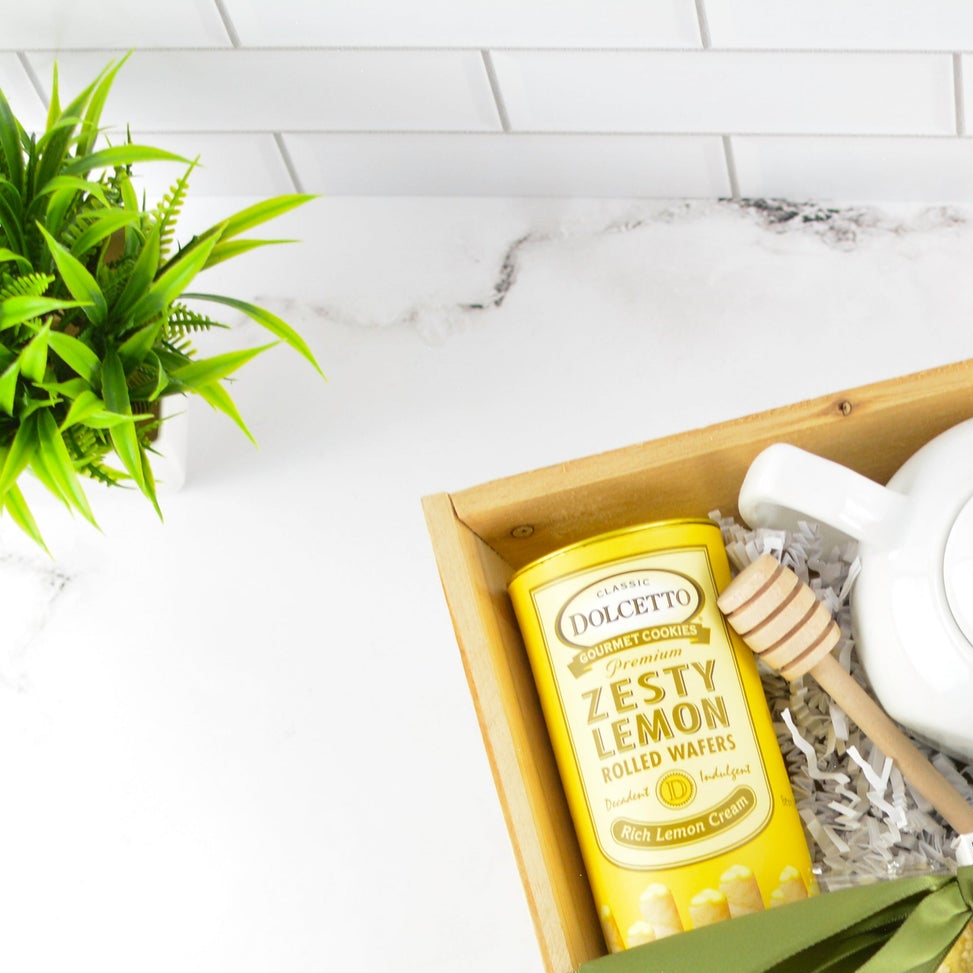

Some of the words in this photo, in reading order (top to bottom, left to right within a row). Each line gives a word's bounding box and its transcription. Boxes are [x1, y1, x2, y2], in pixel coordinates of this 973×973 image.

[596, 578, 650, 598] CLASSIC
[569, 588, 691, 637] DOLCETTO
[580, 633, 639, 664] GOURMET
[642, 625, 698, 641] COOKIES
[605, 648, 682, 678] Premium
[581, 659, 716, 725] ZESTY
[591, 696, 730, 760] LEMON
[601, 751, 662, 784] ROLLED
[667, 734, 736, 762] WAFERS
[605, 787, 649, 812] Decadent
[700, 764, 751, 782] Indulgent
[620, 825, 650, 842] Rich
[656, 821, 705, 842] Lemon
[708, 795, 749, 827] Cream
